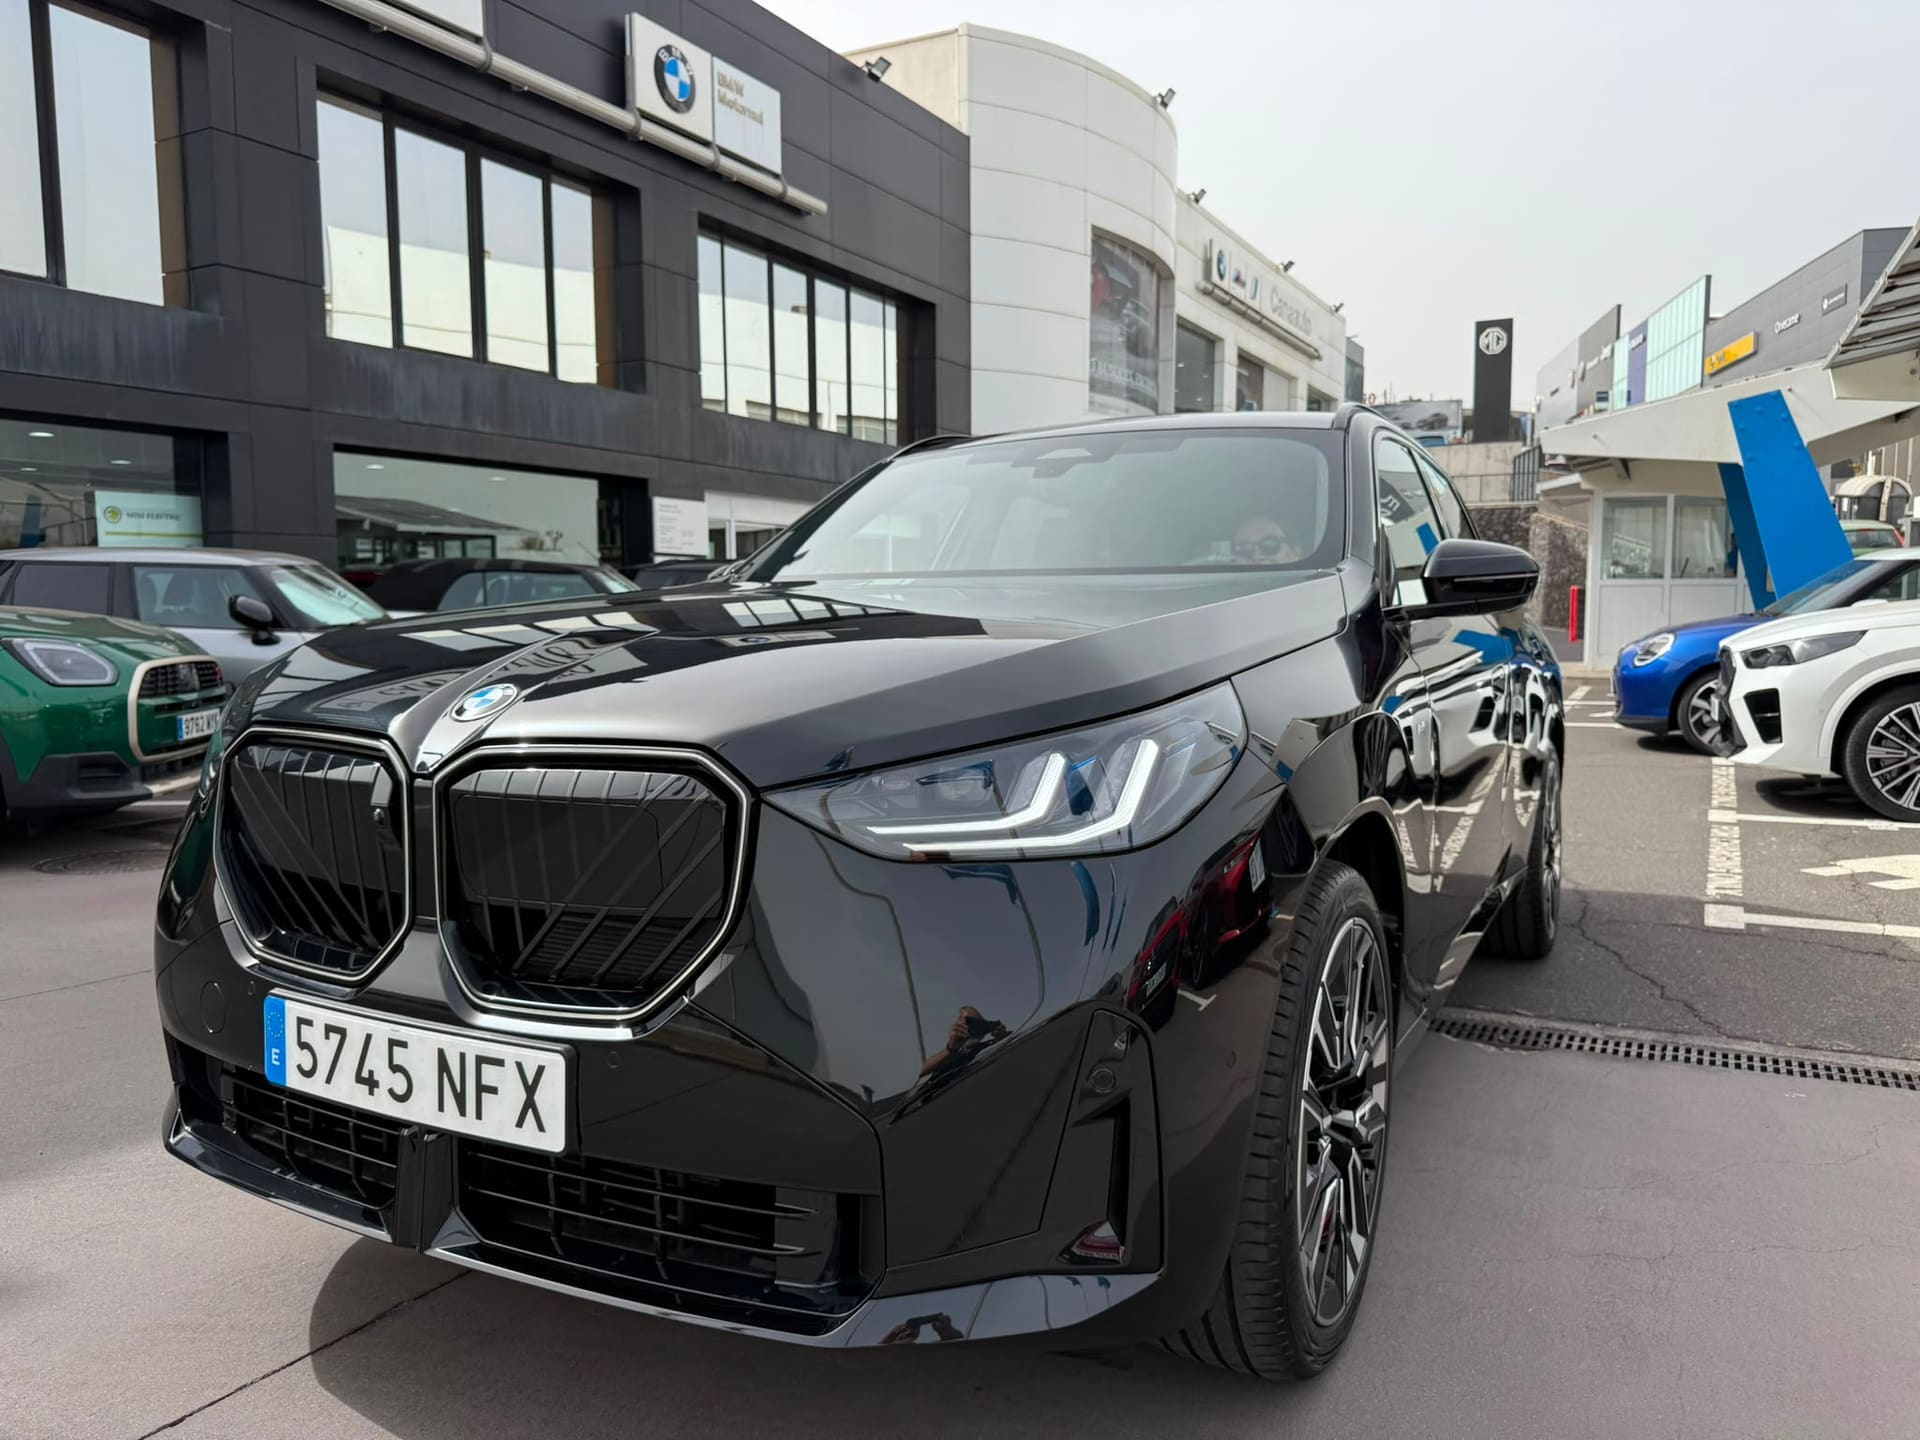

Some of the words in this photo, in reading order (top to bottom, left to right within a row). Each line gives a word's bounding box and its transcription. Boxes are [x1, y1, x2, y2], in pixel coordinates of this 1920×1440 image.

[1480, 329, 1507, 354] MG
[271, 1048, 280, 1065] E
[296, 1016, 413, 1103] 5745
[437, 1047, 546, 1133] NFX
